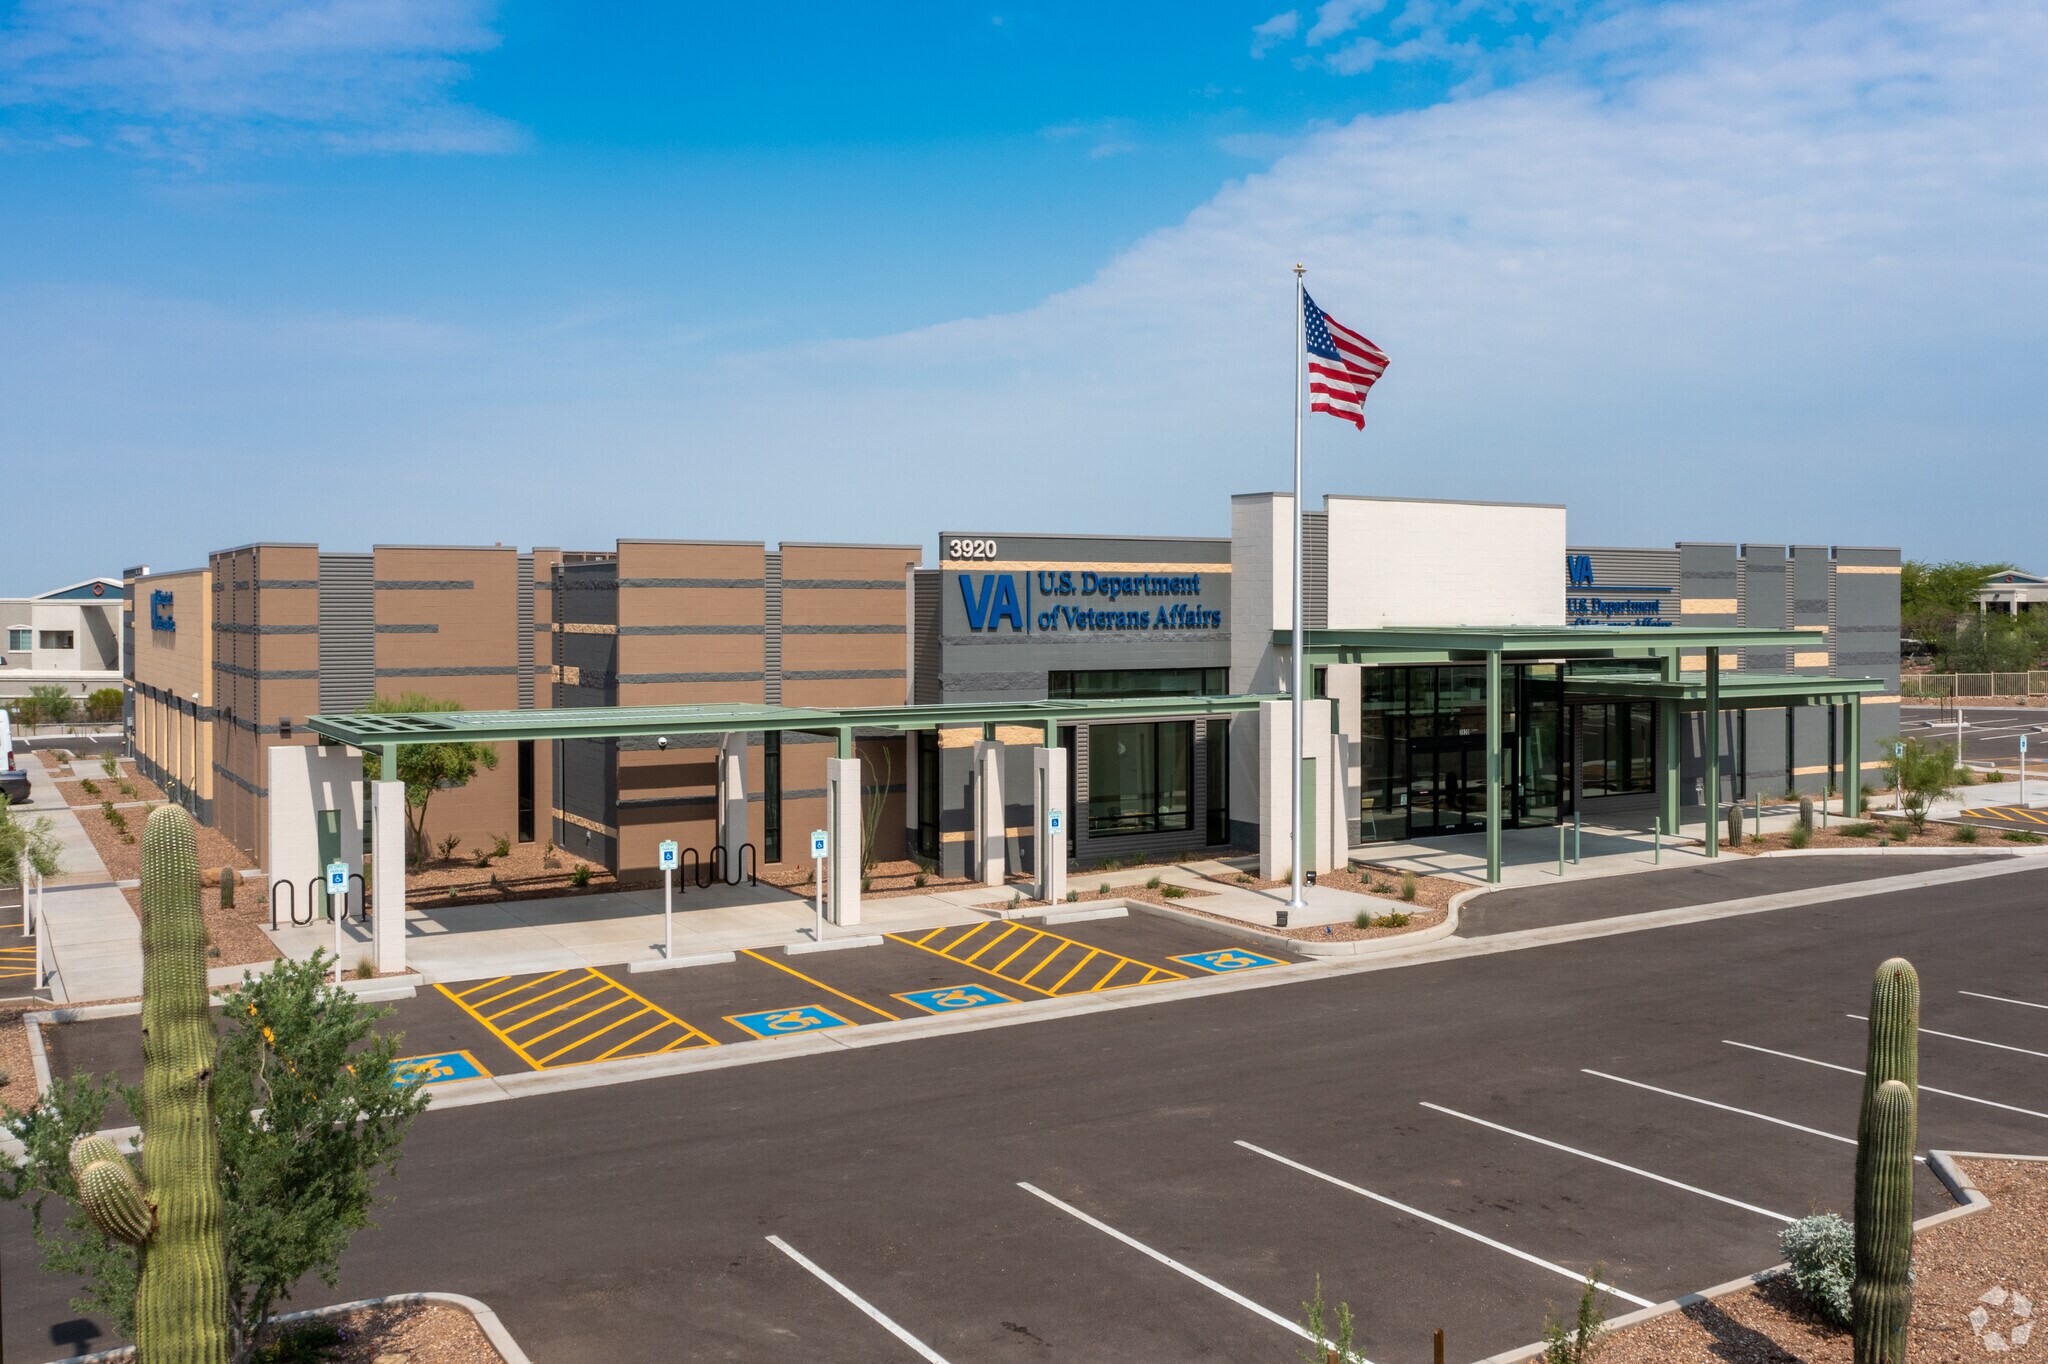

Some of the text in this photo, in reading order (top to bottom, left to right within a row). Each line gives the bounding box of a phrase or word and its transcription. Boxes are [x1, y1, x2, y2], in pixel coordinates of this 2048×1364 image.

[950, 539, 997, 558] 3920
[1567, 555, 1594, 583] VA
[1038, 571, 1201, 599] U.S. Department
[959, 574, 1023, 628] VA
[1038, 604, 1222, 628] of Veterans Affairs
